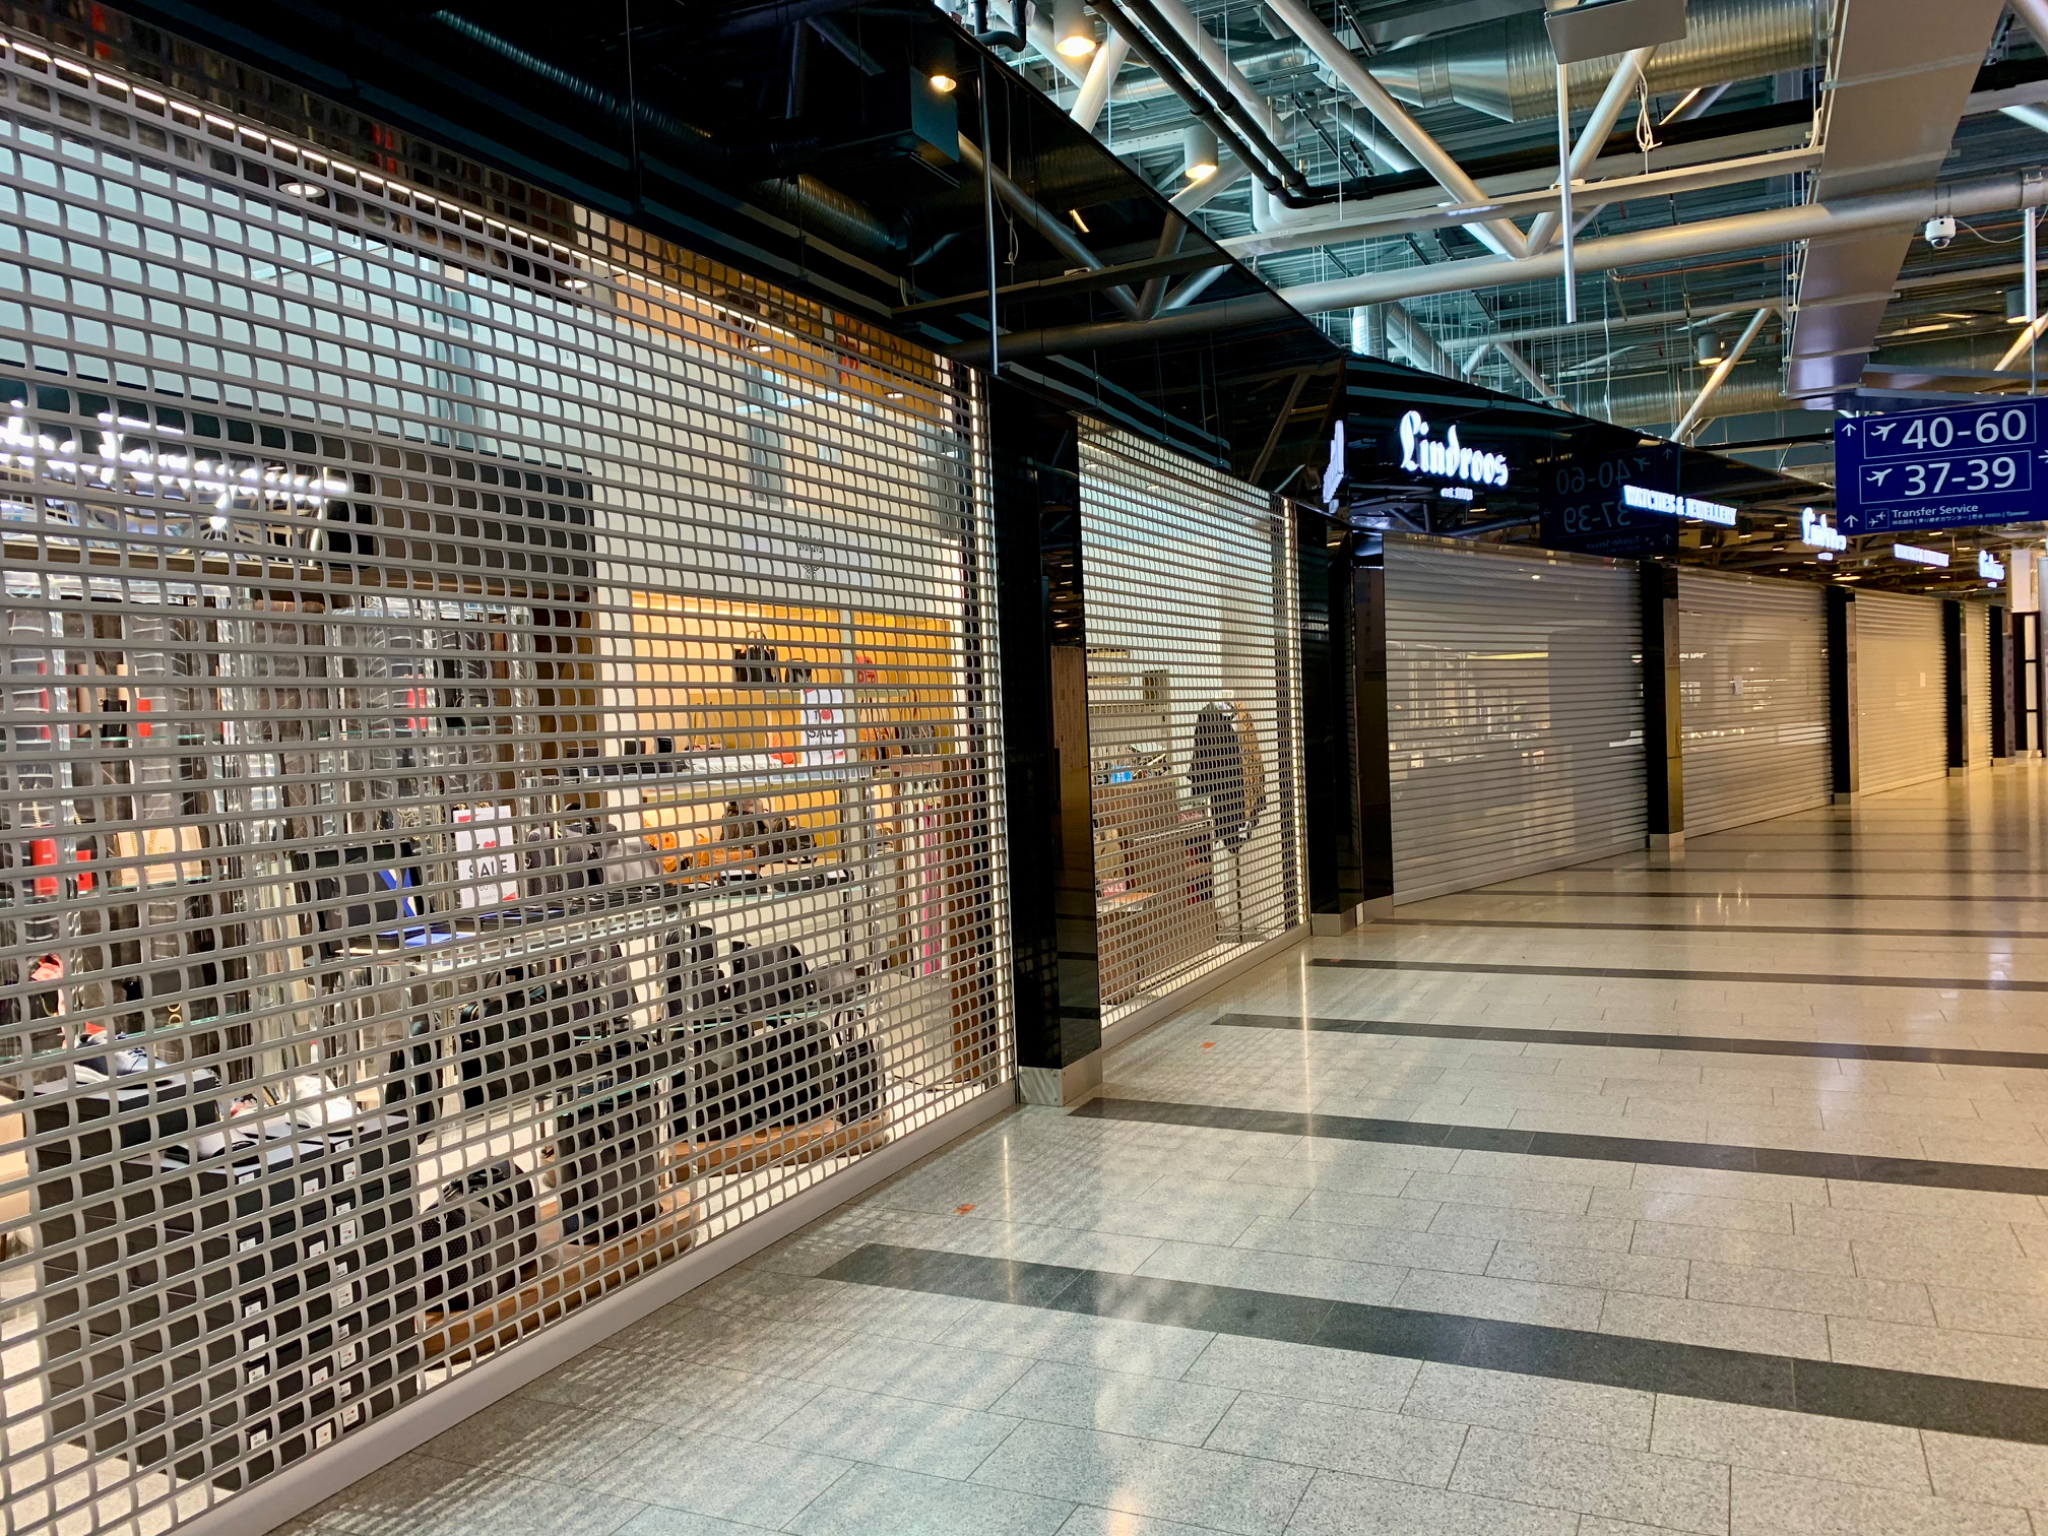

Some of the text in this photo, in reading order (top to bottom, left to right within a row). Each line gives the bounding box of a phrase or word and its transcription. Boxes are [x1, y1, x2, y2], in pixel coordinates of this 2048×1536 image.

[1399, 410, 1509, 486] Lindroos
[1901, 409, 2027, 450] 40-60
[1904, 456, 2017, 496] 37-39
[1623, 484, 1738, 526] WATCHES & JEWELLERY
[1891, 506, 1937, 519] Transfer
[1939, 503, 1979, 515] Service
